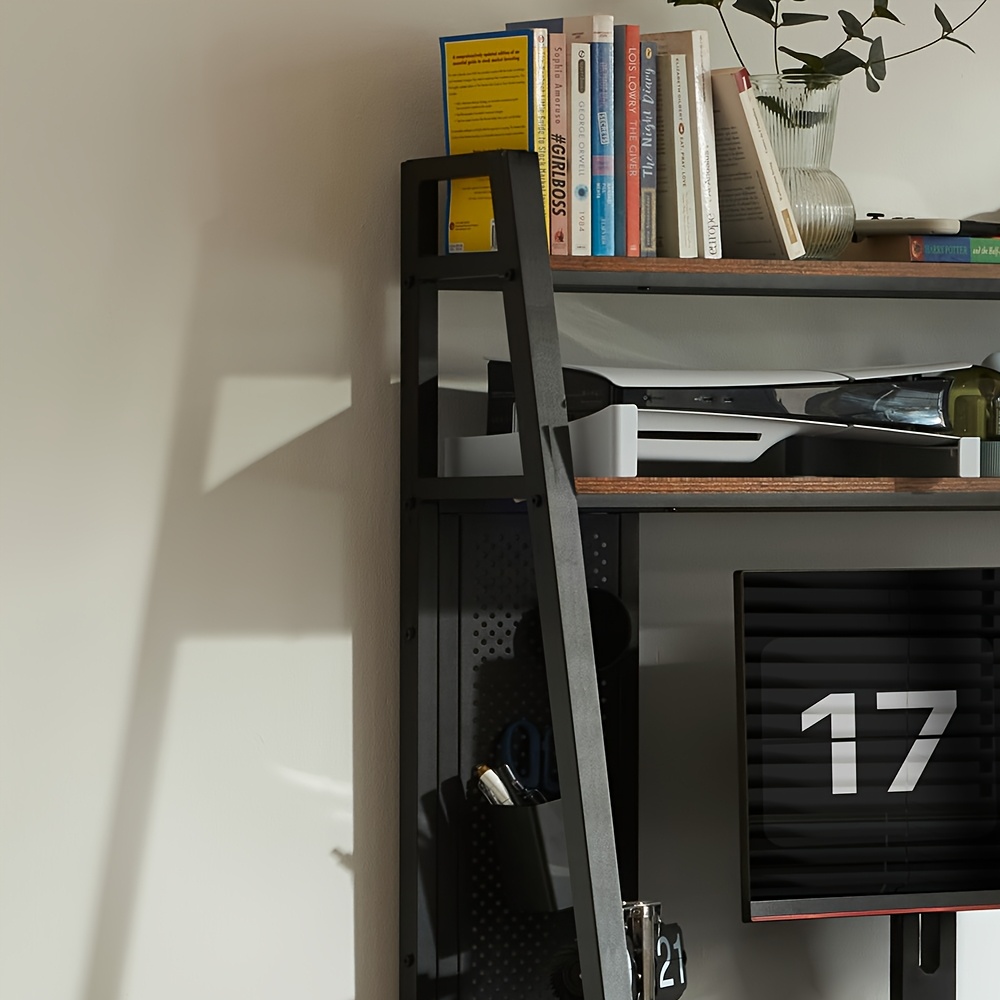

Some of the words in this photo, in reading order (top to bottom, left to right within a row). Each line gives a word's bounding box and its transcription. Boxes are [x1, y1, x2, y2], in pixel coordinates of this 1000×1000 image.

[553, 47, 563, 79] Sophia
[628, 47, 636, 72] LOIS
[554, 84, 562, 124] Amoruso
[628, 76, 636, 113] LOWRY
[642, 68, 656, 105] Diary
[642, 110, 655, 147] Night
[551, 134, 566, 217] #GIRLBOSS
[629, 144, 637, 176] GIVER
[642, 153, 655, 178] The
[800, 690, 958, 795] 17
[656, 933, 686, 989] 21
